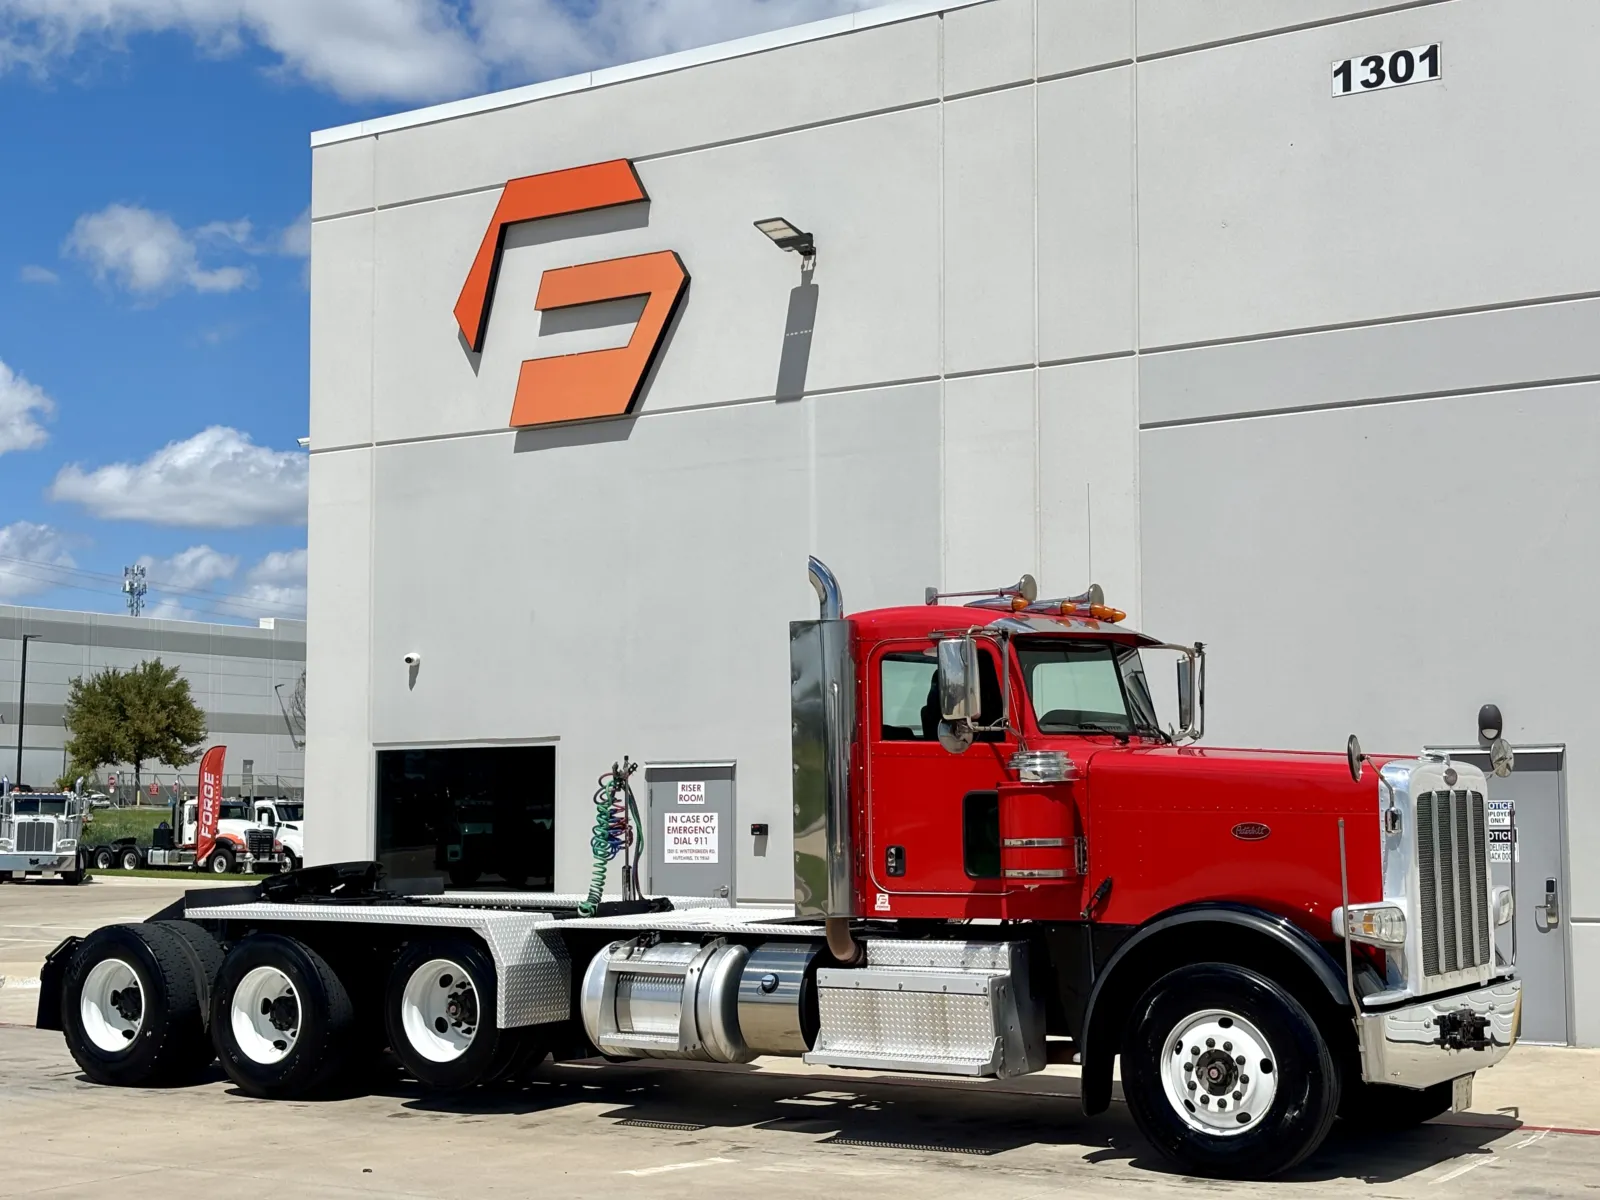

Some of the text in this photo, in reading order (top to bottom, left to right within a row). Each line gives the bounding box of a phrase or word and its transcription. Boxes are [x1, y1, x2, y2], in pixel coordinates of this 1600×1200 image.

[1333, 44, 1438, 93] 1301
[681, 784, 702, 792] RISER
[679, 794, 704, 802] ROOM
[201, 772, 214, 838] FORGE
[1488, 802, 1513, 810] OTICE
[668, 815, 714, 823] IN CASE OF
[667, 826, 716, 834] EMERGENCY
[1489, 832, 1511, 840] OTICE
[673, 837, 708, 845] DIAL 911
